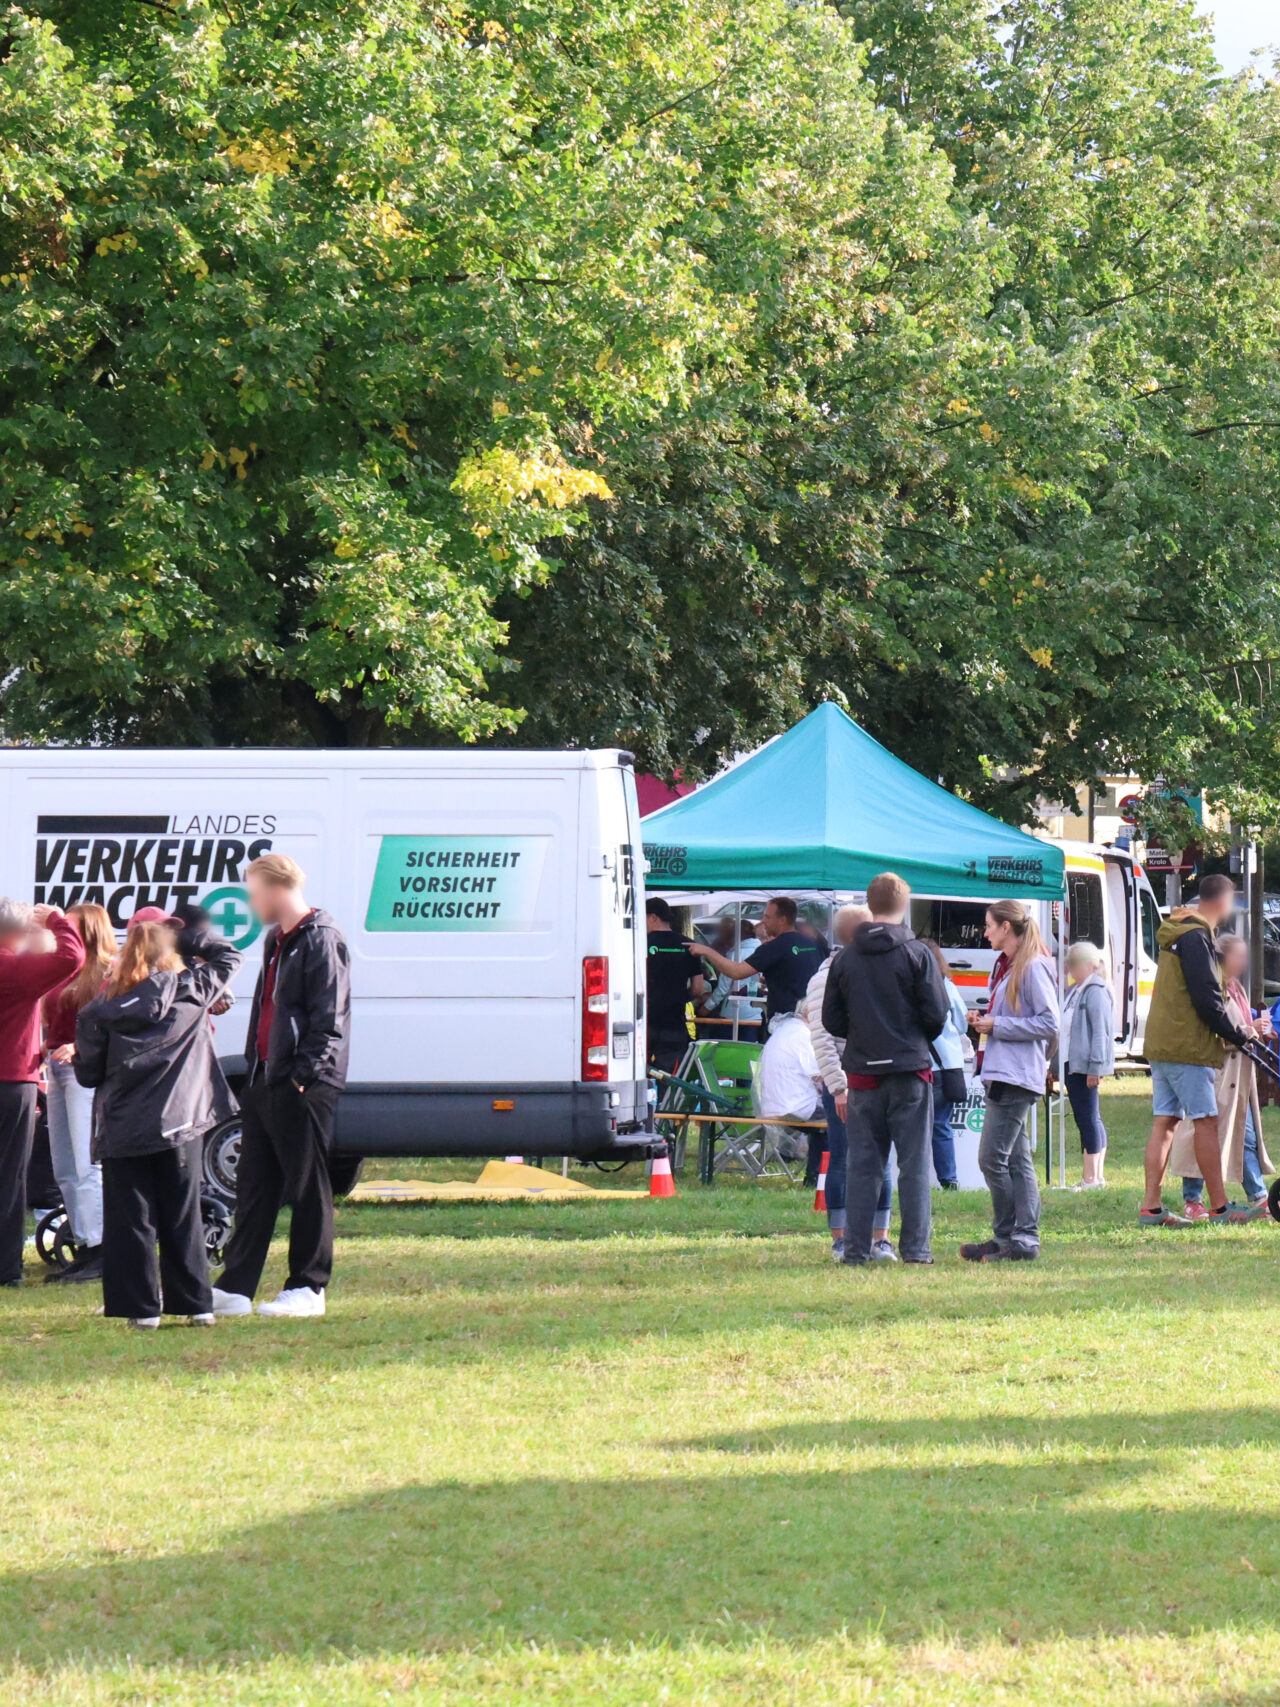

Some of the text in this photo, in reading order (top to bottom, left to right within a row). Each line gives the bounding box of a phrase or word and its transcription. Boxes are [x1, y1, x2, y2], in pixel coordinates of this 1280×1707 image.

[172, 815, 277, 835] LANDES
[405, 851, 521, 868] SICHERHEIT
[987, 859, 1044, 871] VERKEHRS
[399, 876, 497, 893] VORSICHT
[392, 896, 502, 919] RÜCKSICHT
